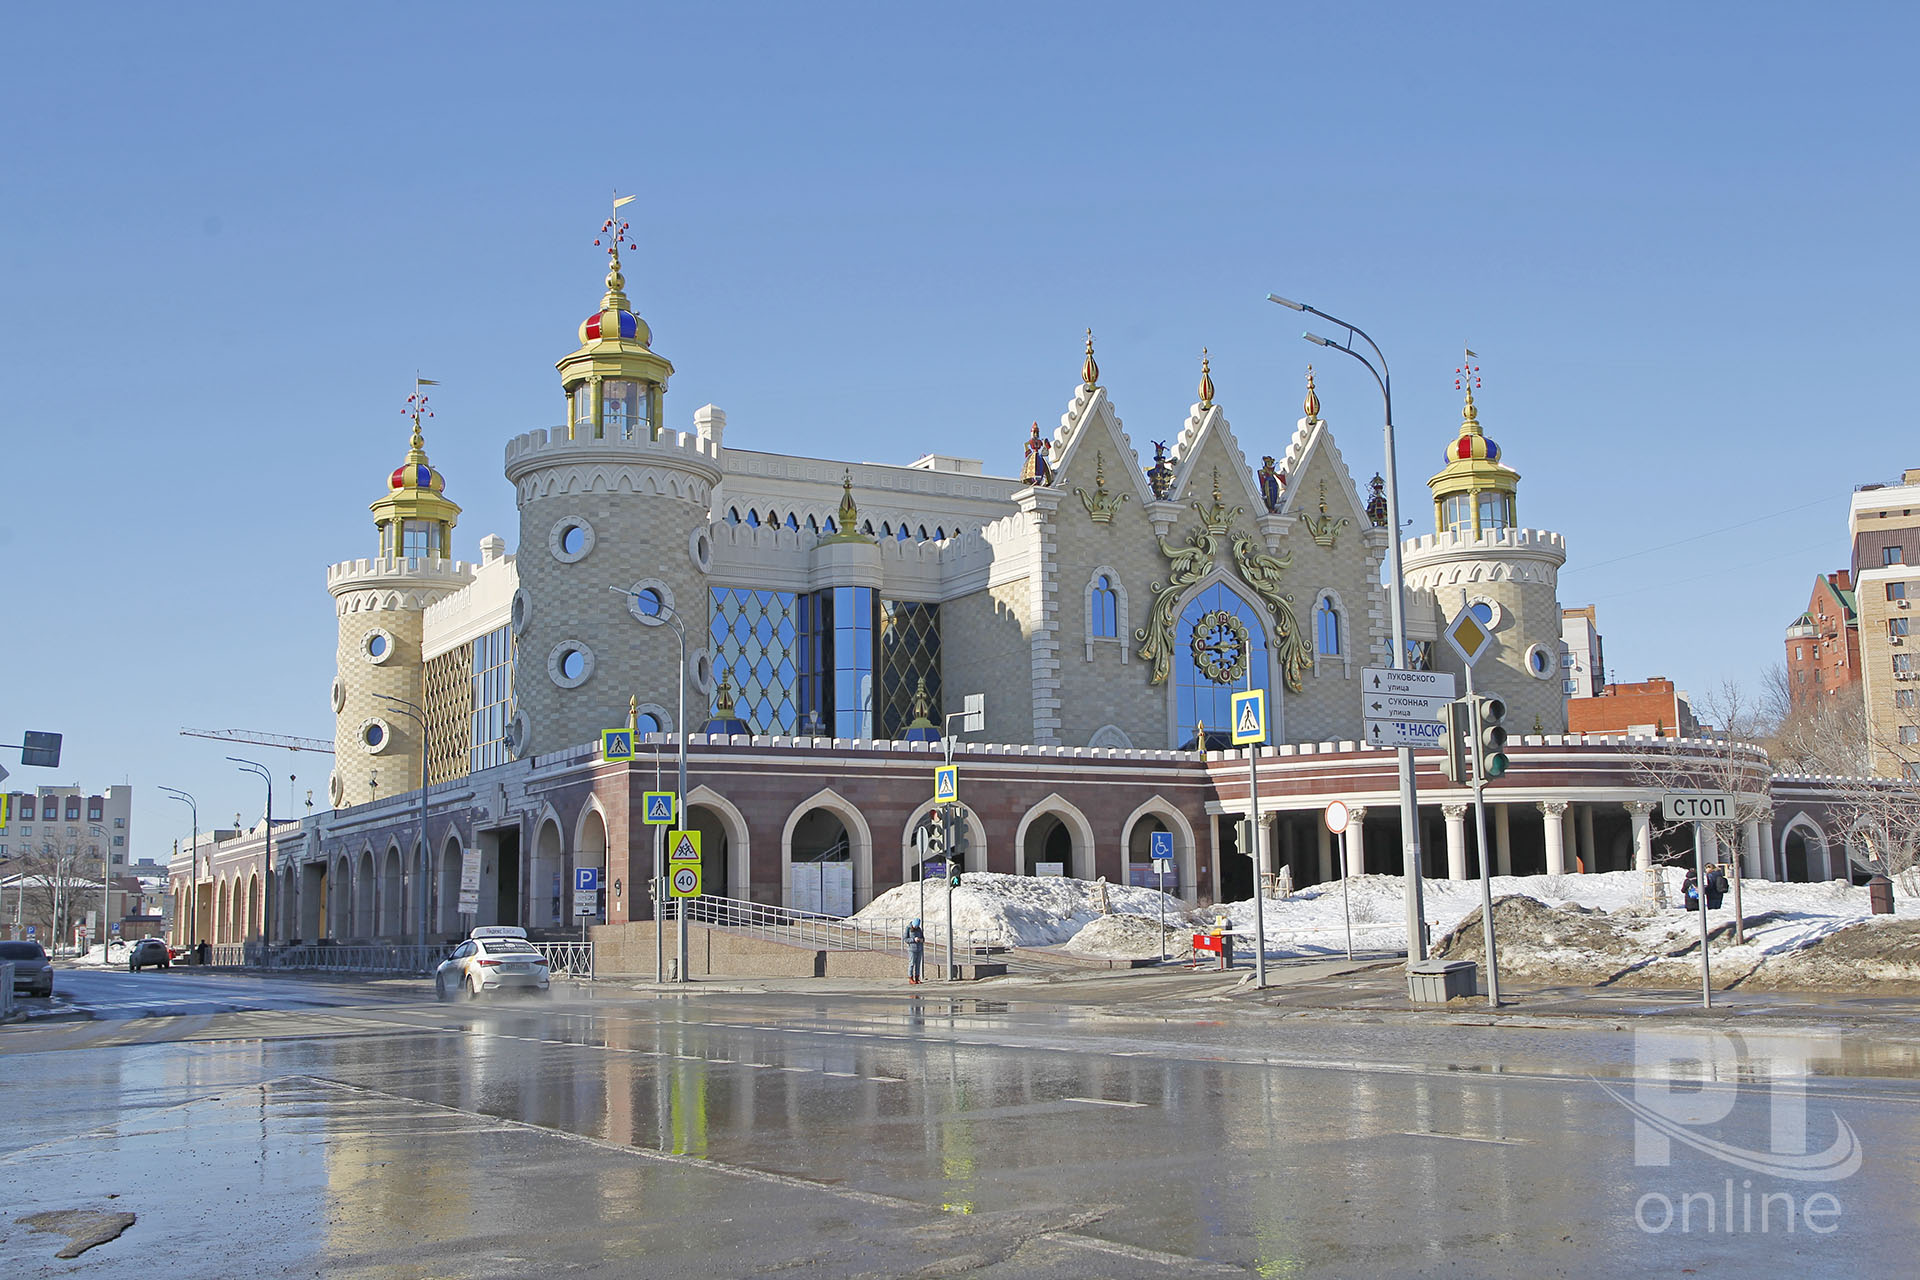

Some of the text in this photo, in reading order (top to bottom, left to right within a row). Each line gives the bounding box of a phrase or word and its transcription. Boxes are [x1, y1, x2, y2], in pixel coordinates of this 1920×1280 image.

[1387, 672, 1436, 683] ЛУКОВСКОГО
[1387, 684, 1410, 692] улица
[1388, 697, 1429, 707] СУКОННАЯ
[1673, 799, 1726, 816] СТОП
[580, 870, 592, 888] P
[678, 876, 693, 886] 40
